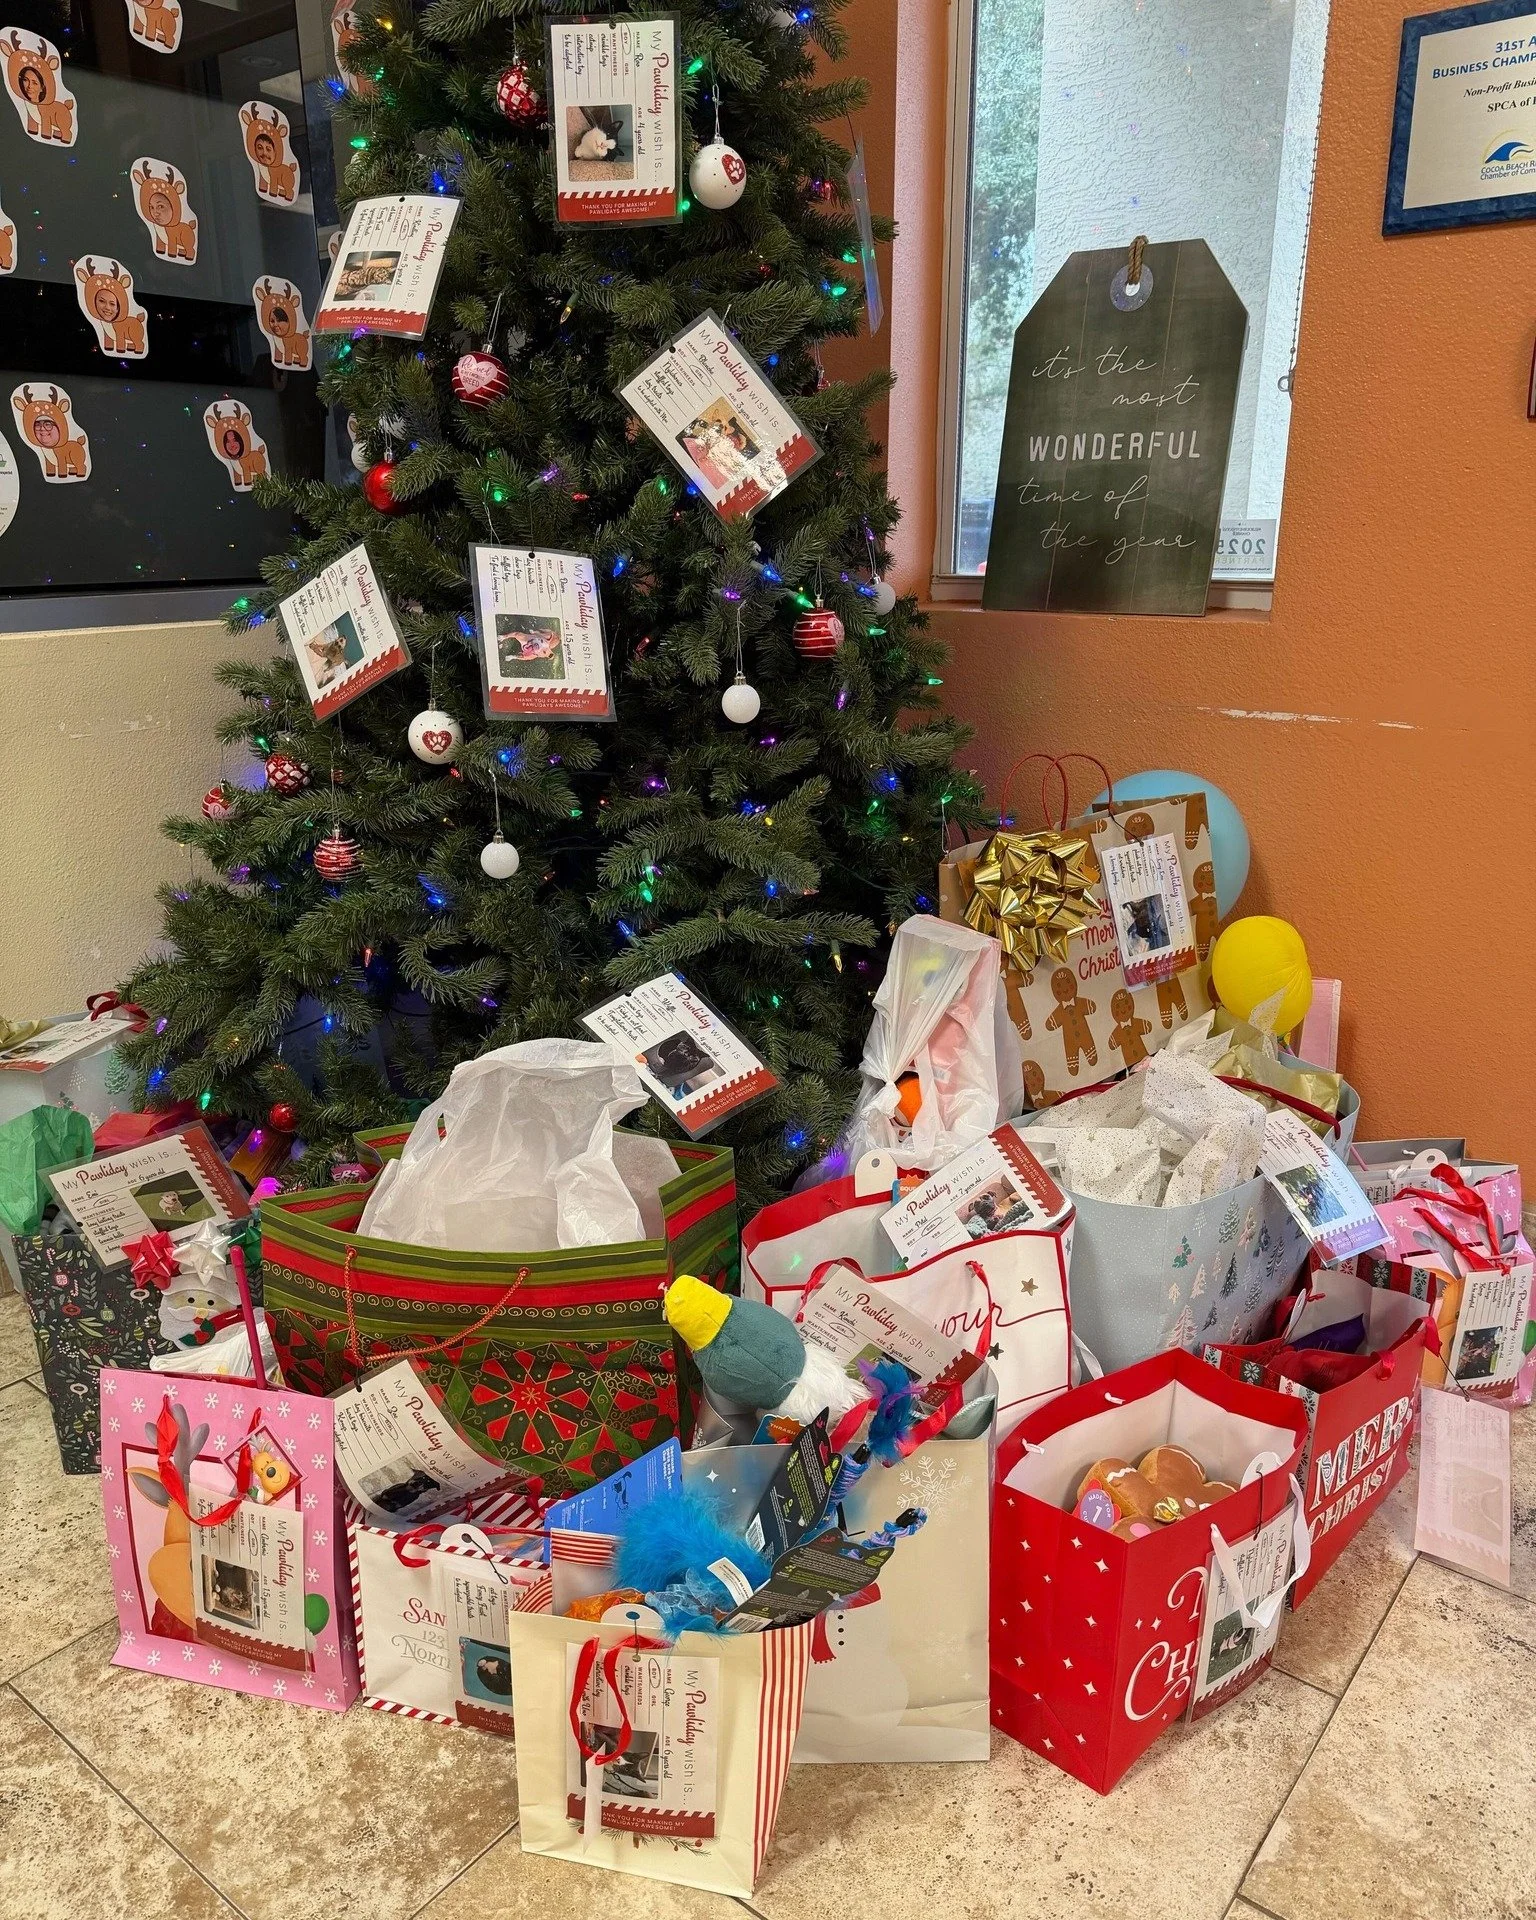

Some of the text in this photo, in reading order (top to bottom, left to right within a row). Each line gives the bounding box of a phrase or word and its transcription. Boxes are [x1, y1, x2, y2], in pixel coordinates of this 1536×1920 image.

[574, 34, 584, 75] interactive toy
[586, 33, 596, 52] catnip
[1496, 40, 1525, 53] 31ST
[562, 48, 573, 70] adopted
[598, 54, 608, 67] toys
[1493, 53, 1536, 67] CHAMP
[1464, 78, 1536, 97] Non-Profit Busi
[647, 30, 669, 181] My Pawliday wish is...
[1487, 100, 1517, 112] SPCA
[1520, 97, 1531, 107] of
[634, 130, 642, 144] years
[1480, 172, 1510, 180] Chamber
[1506, 162, 1528, 170] BEACH
[429, 208, 442, 220] My
[412, 222, 442, 261] Pawliday
[411, 264, 423, 286] wish
[687, 341, 698, 354] NAME
[1096, 346, 1157, 375] the
[698, 329, 714, 346] My
[712, 341, 749, 392] Pawliday
[748, 390, 769, 416] wish
[1112, 375, 1199, 407] most
[736, 401, 744, 409] 3
[738, 408, 750, 420] years
[749, 419, 758, 427] old
[1030, 430, 1200, 462] WONDERFUL
[1017, 475, 1149, 519] time of
[1040, 522, 1196, 565] the year
[573, 563, 583, 580] My
[350, 554, 358, 569] My
[354, 564, 374, 608] Pawliday
[368, 606, 380, 628] wish
[574, 581, 594, 628] Pawliday
[582, 633, 592, 659] wish
[1164, 840, 1184, 922] My Pawliday wish
[1079, 946, 1121, 980] Christ
[662, 980, 677, 993] My
[675, 991, 711, 1029] Pawliday
[710, 1029, 731, 1050] wish
[1298, 1127, 1332, 1168] Pawliday
[61, 1180, 78, 1190] My
[76, 1162, 128, 1185] Pawliday
[129, 1155, 156, 1168] wish
[145, 1172, 157, 1181] years
[894, 1214, 909, 1227] My
[906, 1184, 951, 1216] Pawliday
[950, 1166, 974, 1184] wish
[964, 1183, 975, 1194] years
[1519, 1275, 1526, 1288] My
[835, 1286, 853, 1302] My
[852, 1293, 898, 1336] Pawliday
[898, 1330, 923, 1350] wish
[1510, 1290, 1527, 1331] Pawliday
[823, 1302, 836, 1312] NAME
[889, 1348, 903, 1358] years
[393, 1379, 467, 1472] My Pawliday wish
[1309, 1396, 1412, 1512] MER
[1088, 1493, 1103, 1501] MADE
[1308, 1446, 1398, 1546] CHRIST
[275, 1520, 287, 1537] My
[272, 1539, 294, 1586] Pawliday
[278, 1590, 287, 1616] wish
[403, 1598, 447, 1627] SAN
[423, 1630, 445, 1649] 123
[592, 1686, 602, 1697] toy
[622, 1665, 632, 1696] crinkle toys
[676, 1670, 706, 1806] My Pawliday wish is...
[660, 1755, 669, 1769] years
[663, 1770, 673, 1779] old
[602, 1817, 639, 1828] PAWLIDAYS
[616, 1814, 630, 1822] YOU
